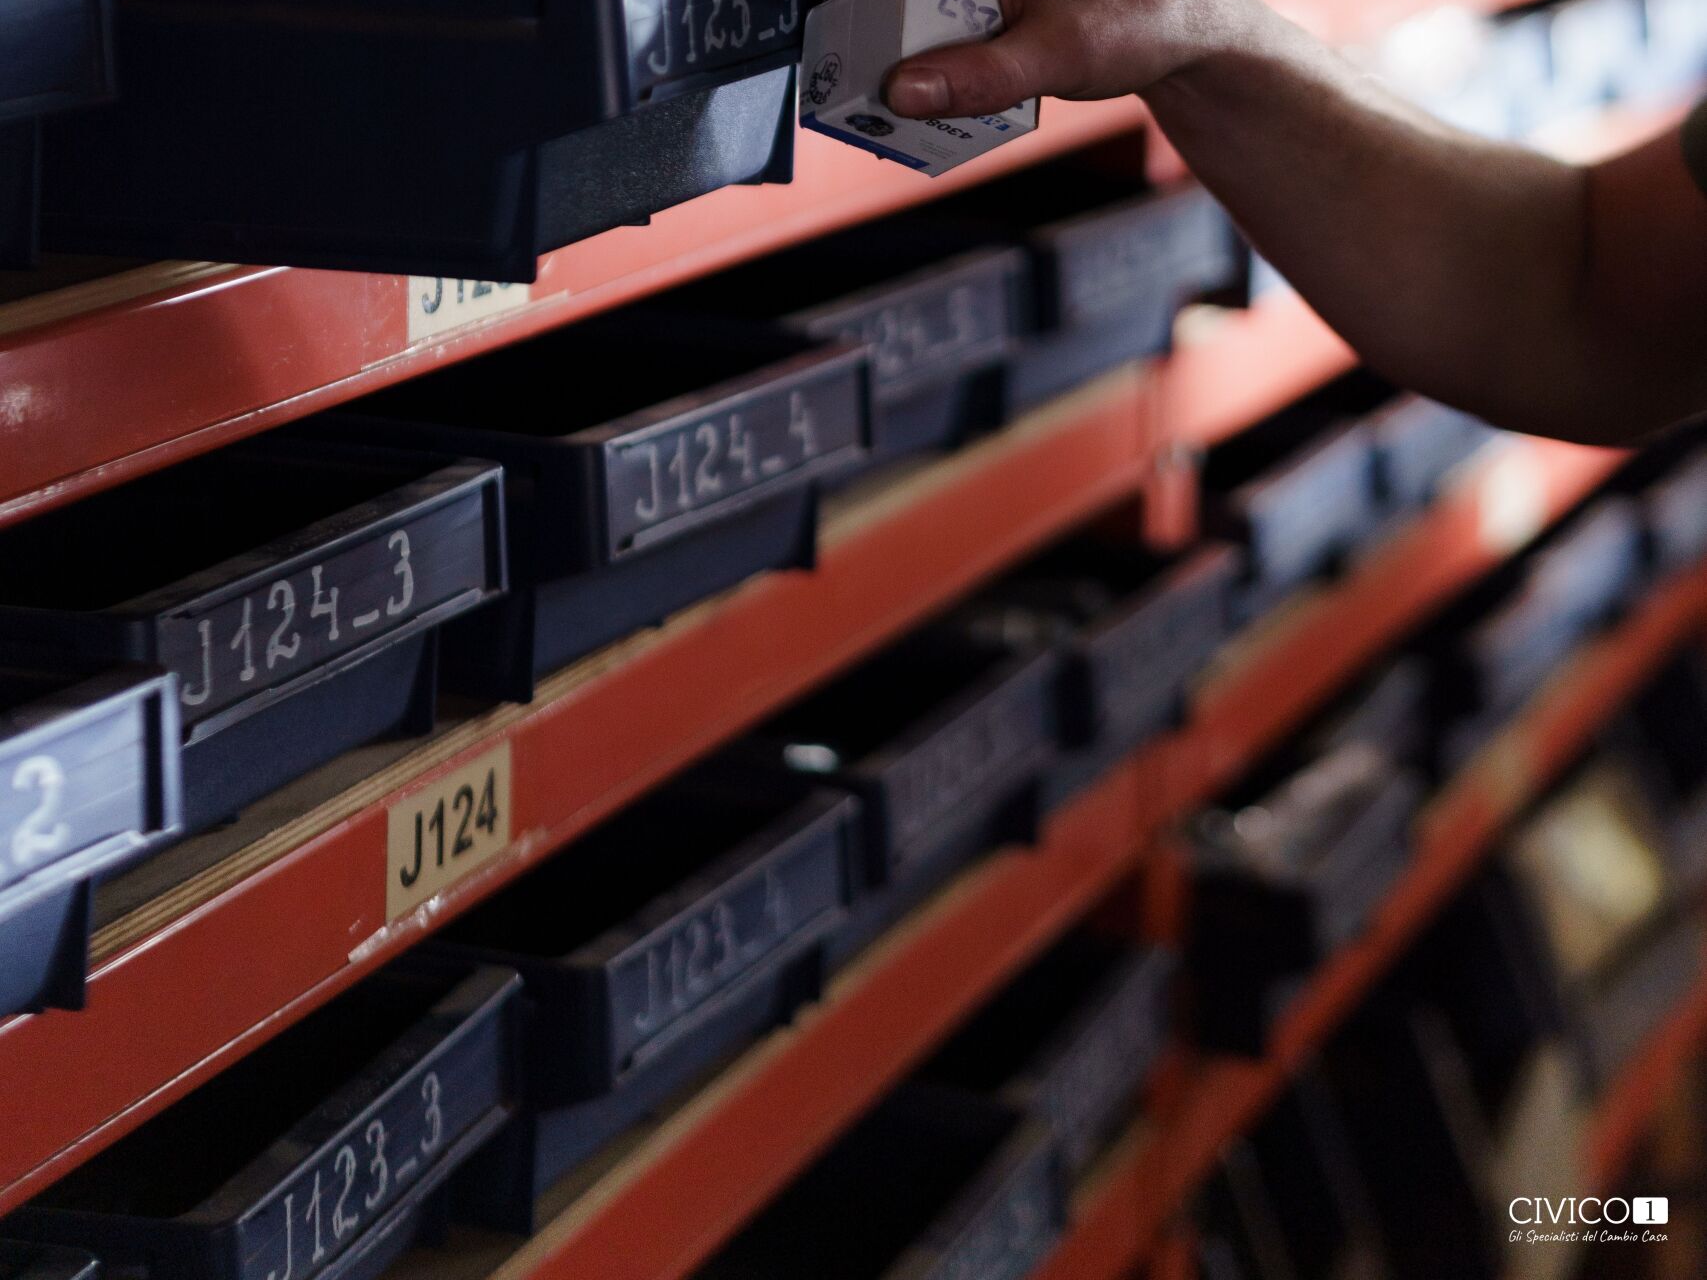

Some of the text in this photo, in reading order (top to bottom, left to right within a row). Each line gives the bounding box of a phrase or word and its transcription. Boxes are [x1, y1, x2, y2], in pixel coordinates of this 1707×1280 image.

[914, 117, 973, 139] 4308
[635, 392, 819, 519] J124_4
[182, 529, 414, 705] J124_3
[400, 768, 497, 888] J124
[267, 1072, 442, 1280] J123_3
